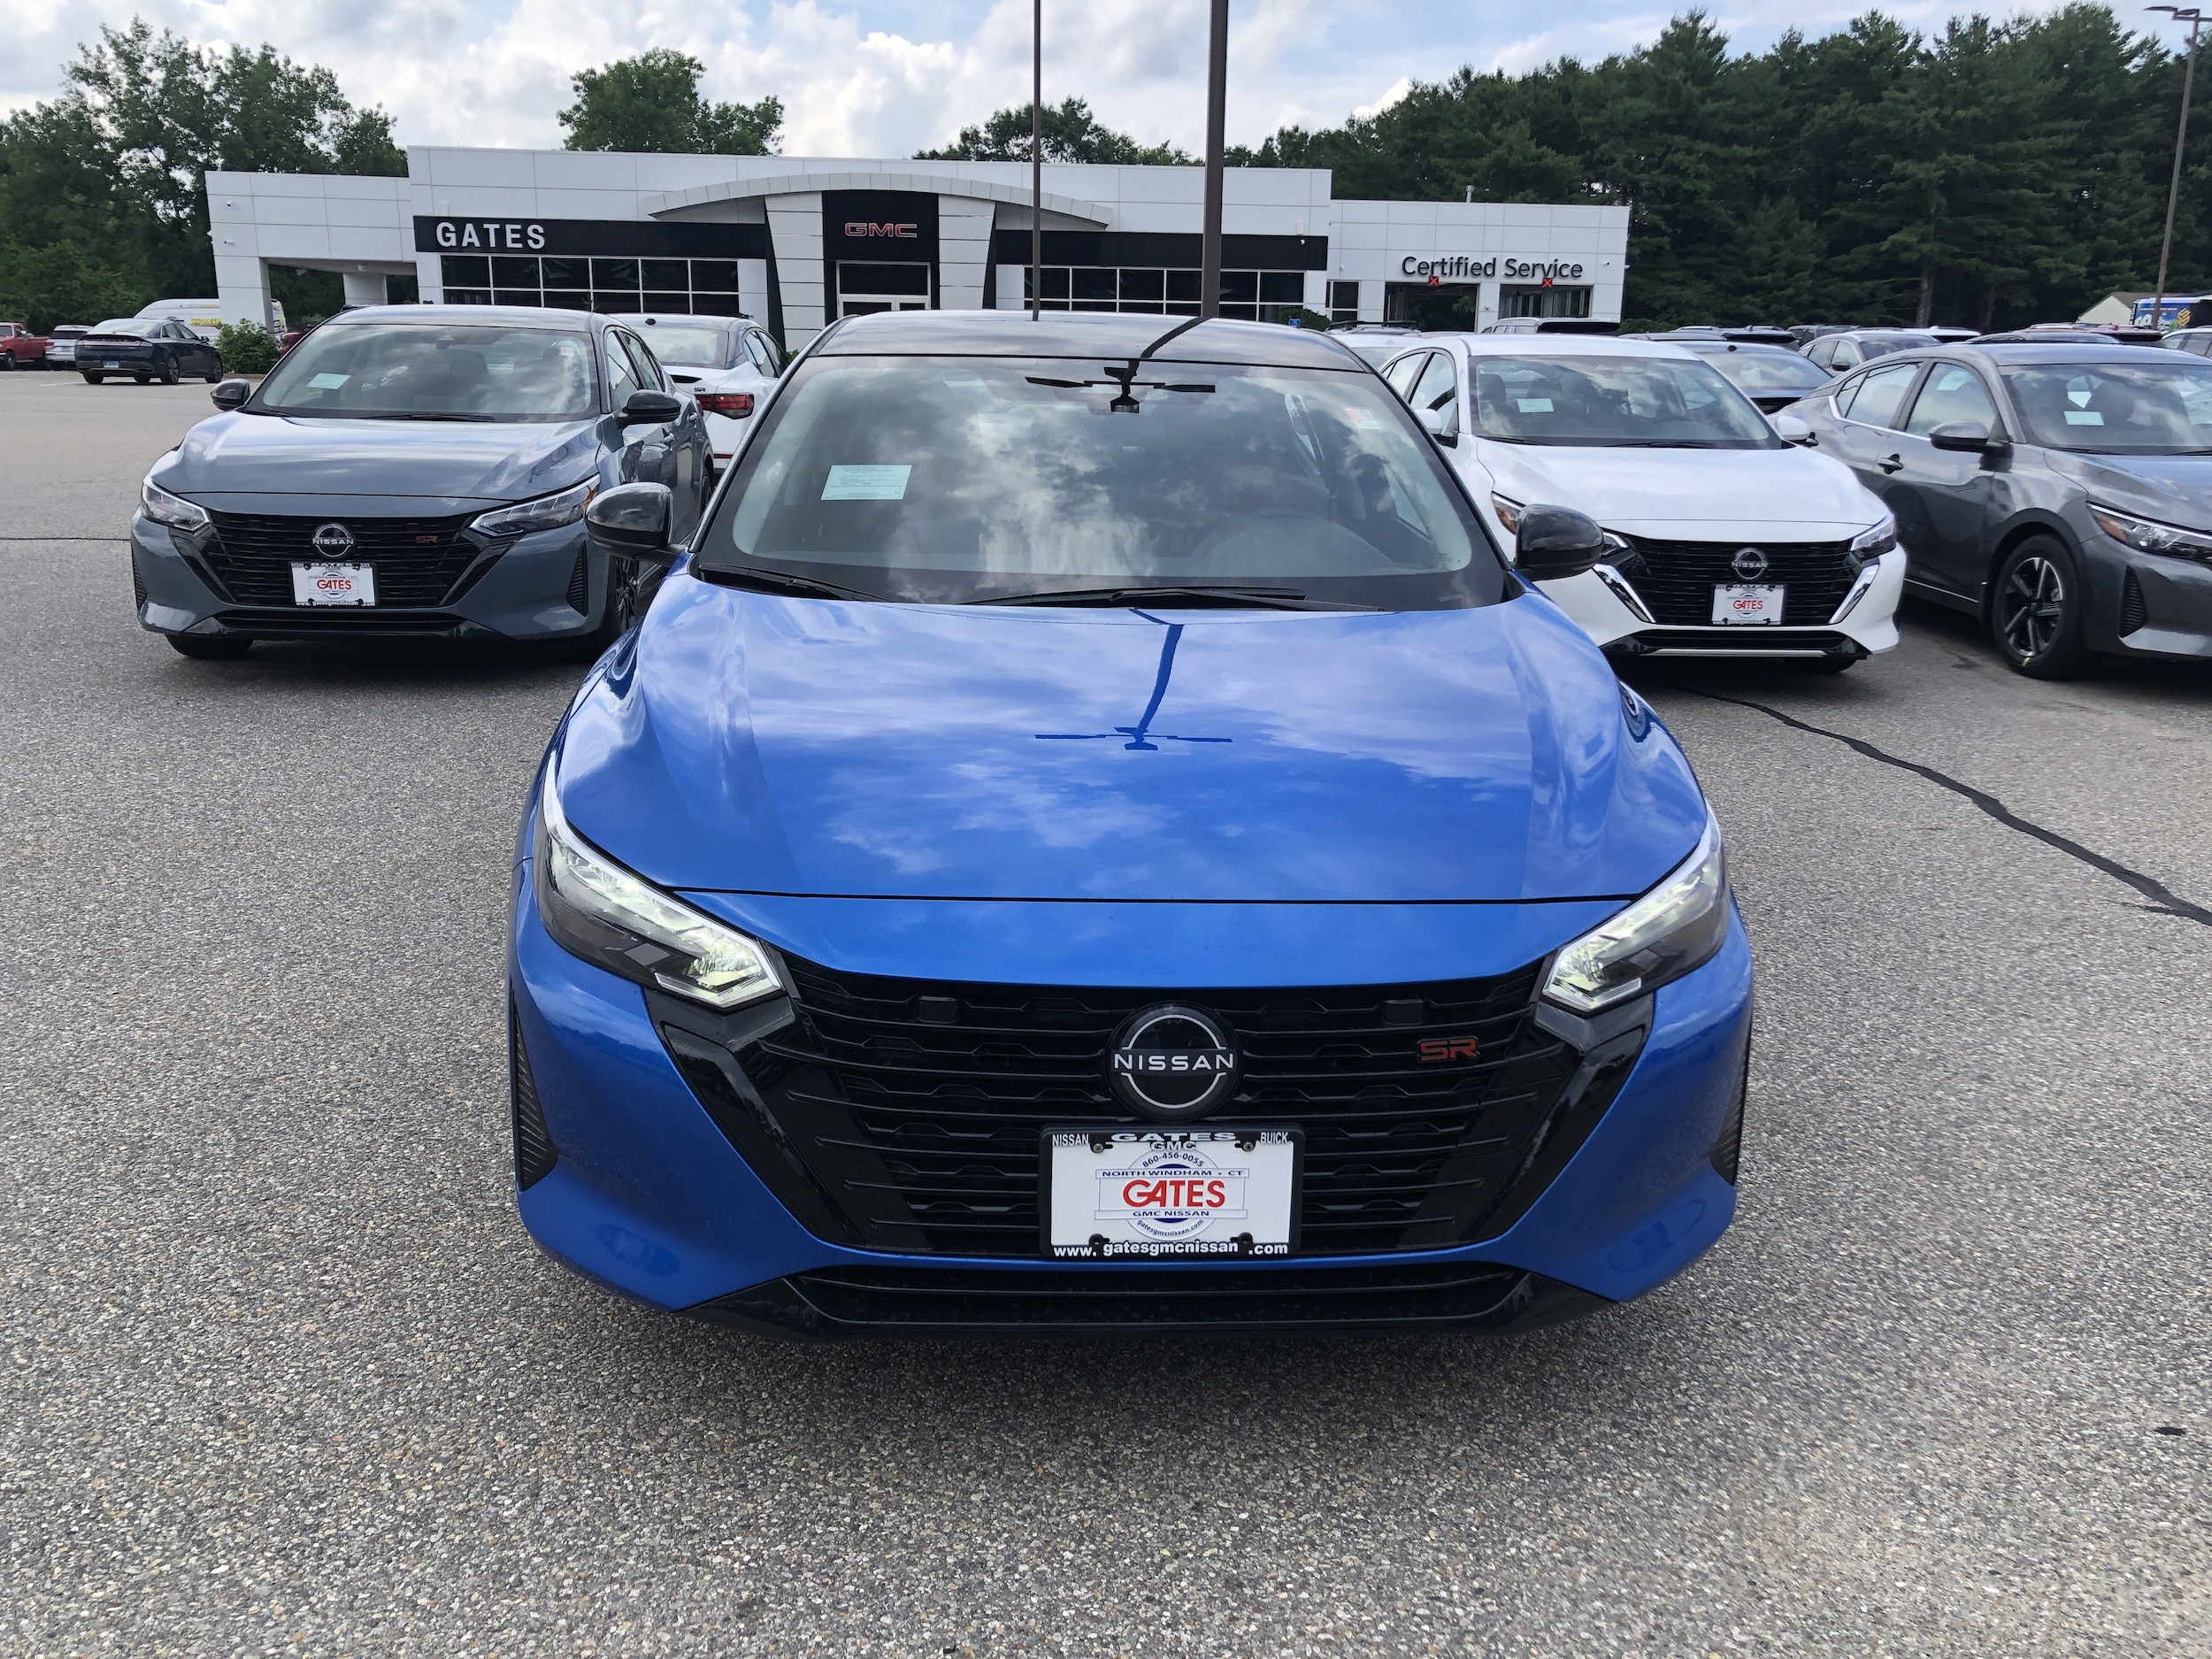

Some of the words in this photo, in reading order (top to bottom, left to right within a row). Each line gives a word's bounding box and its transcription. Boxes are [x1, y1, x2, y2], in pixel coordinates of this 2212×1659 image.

[436, 221, 545, 250] GATES
[845, 222, 917, 238] GMC
[1402, 256, 1496, 277] Certified
[1504, 258, 1583, 279] Service
[415, 535, 438, 544] SR
[317, 580, 351, 590] GATES
[1733, 600, 1763, 610] GATES
[1418, 1036, 1480, 1062] SR
[1114, 1053, 1234, 1071] NISSAN
[1052, 1133, 1089, 1147] NISSAN
[1111, 1133, 1236, 1142] GATES
[1150, 1141, 1196, 1150] GMC
[1260, 1132, 1288, 1144] BUICK
[1142, 1151, 1204, 1168] 860-456-0055
[1123, 1179, 1225, 1208] GATES
[1137, 1218, 1204, 1236] gatesgmcnissan.com
[1054, 1247, 1096, 1256] www.
[1102, 1240, 1238, 1256] gatesgmcnissan
[1248, 1243, 1288, 1255] .com
